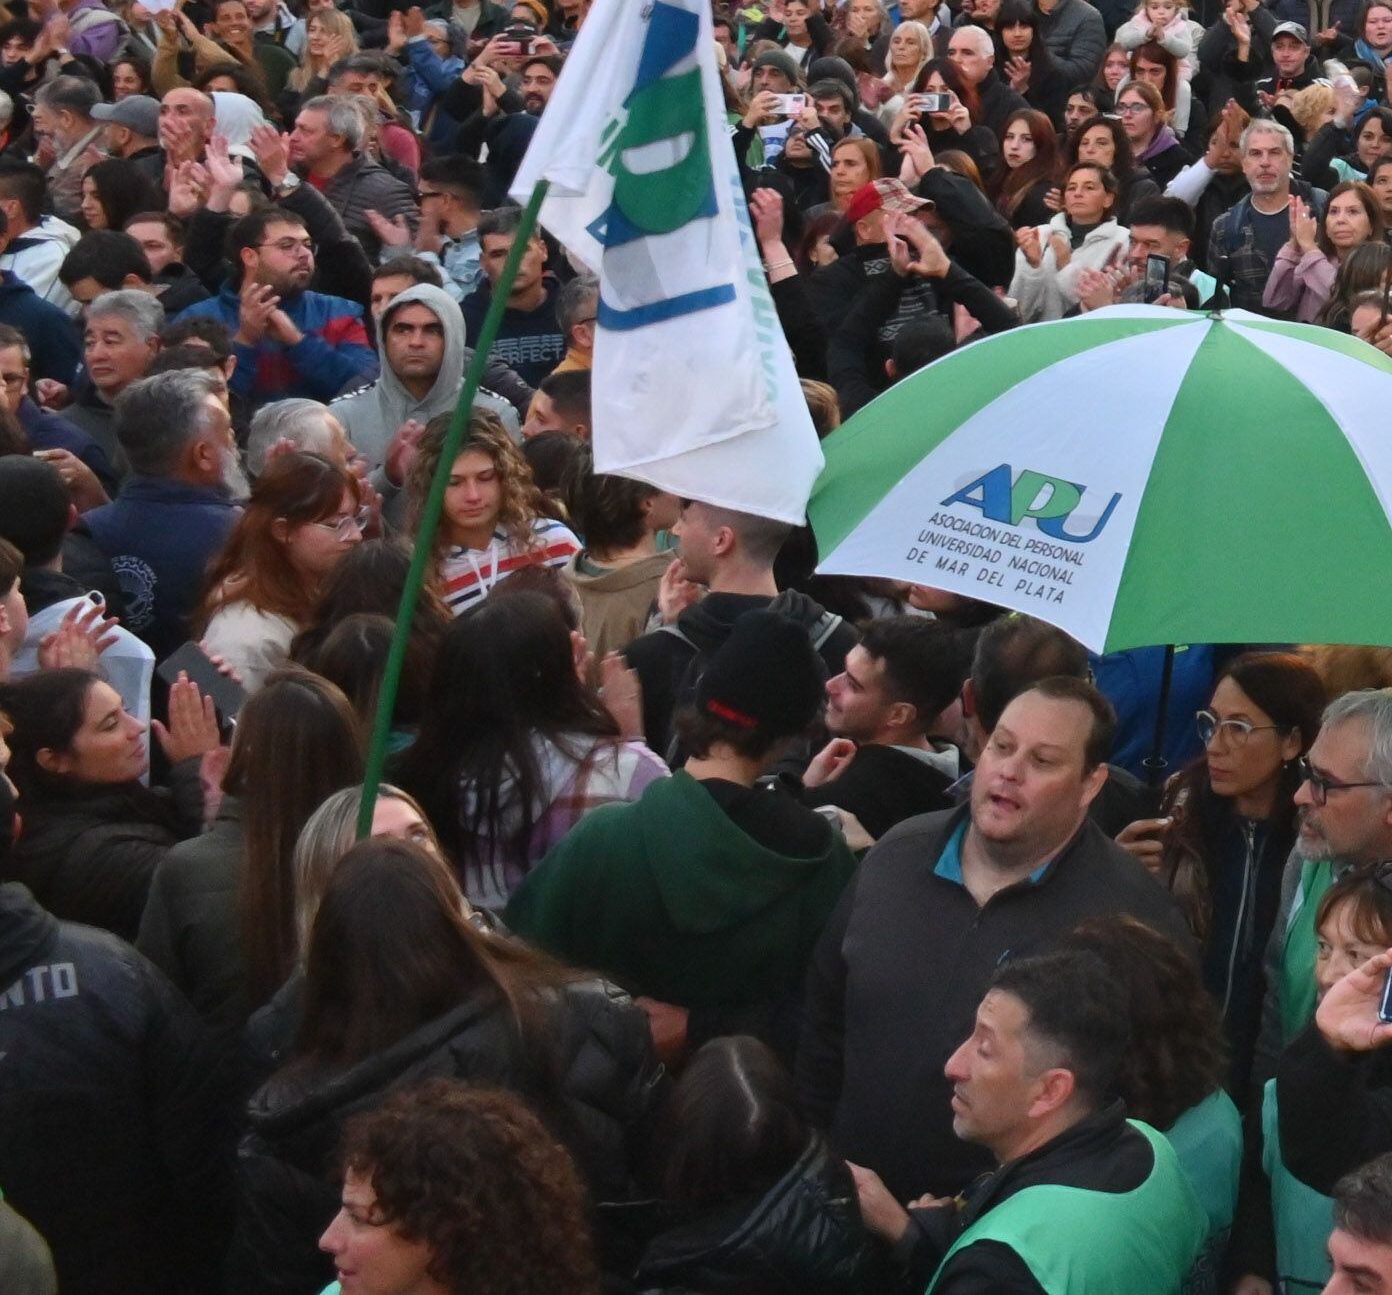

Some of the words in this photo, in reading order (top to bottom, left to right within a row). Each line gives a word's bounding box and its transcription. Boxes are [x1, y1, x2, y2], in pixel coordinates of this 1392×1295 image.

[940, 463, 1123, 544] APU
[918, 529, 1002, 564] UNIVERSIDAD
[1008, 556, 1074, 585] NACIONAL
[928, 512, 1001, 542] ASOCIACION
[1000, 532, 1022, 549] DEL
[1026, 539, 1084, 566] PERSONAL
[906, 546, 928, 564] DE
[936, 556, 969, 577] MAR
[976, 568, 1004, 587] DEL
[1014, 579, 1065, 604] PLATA
